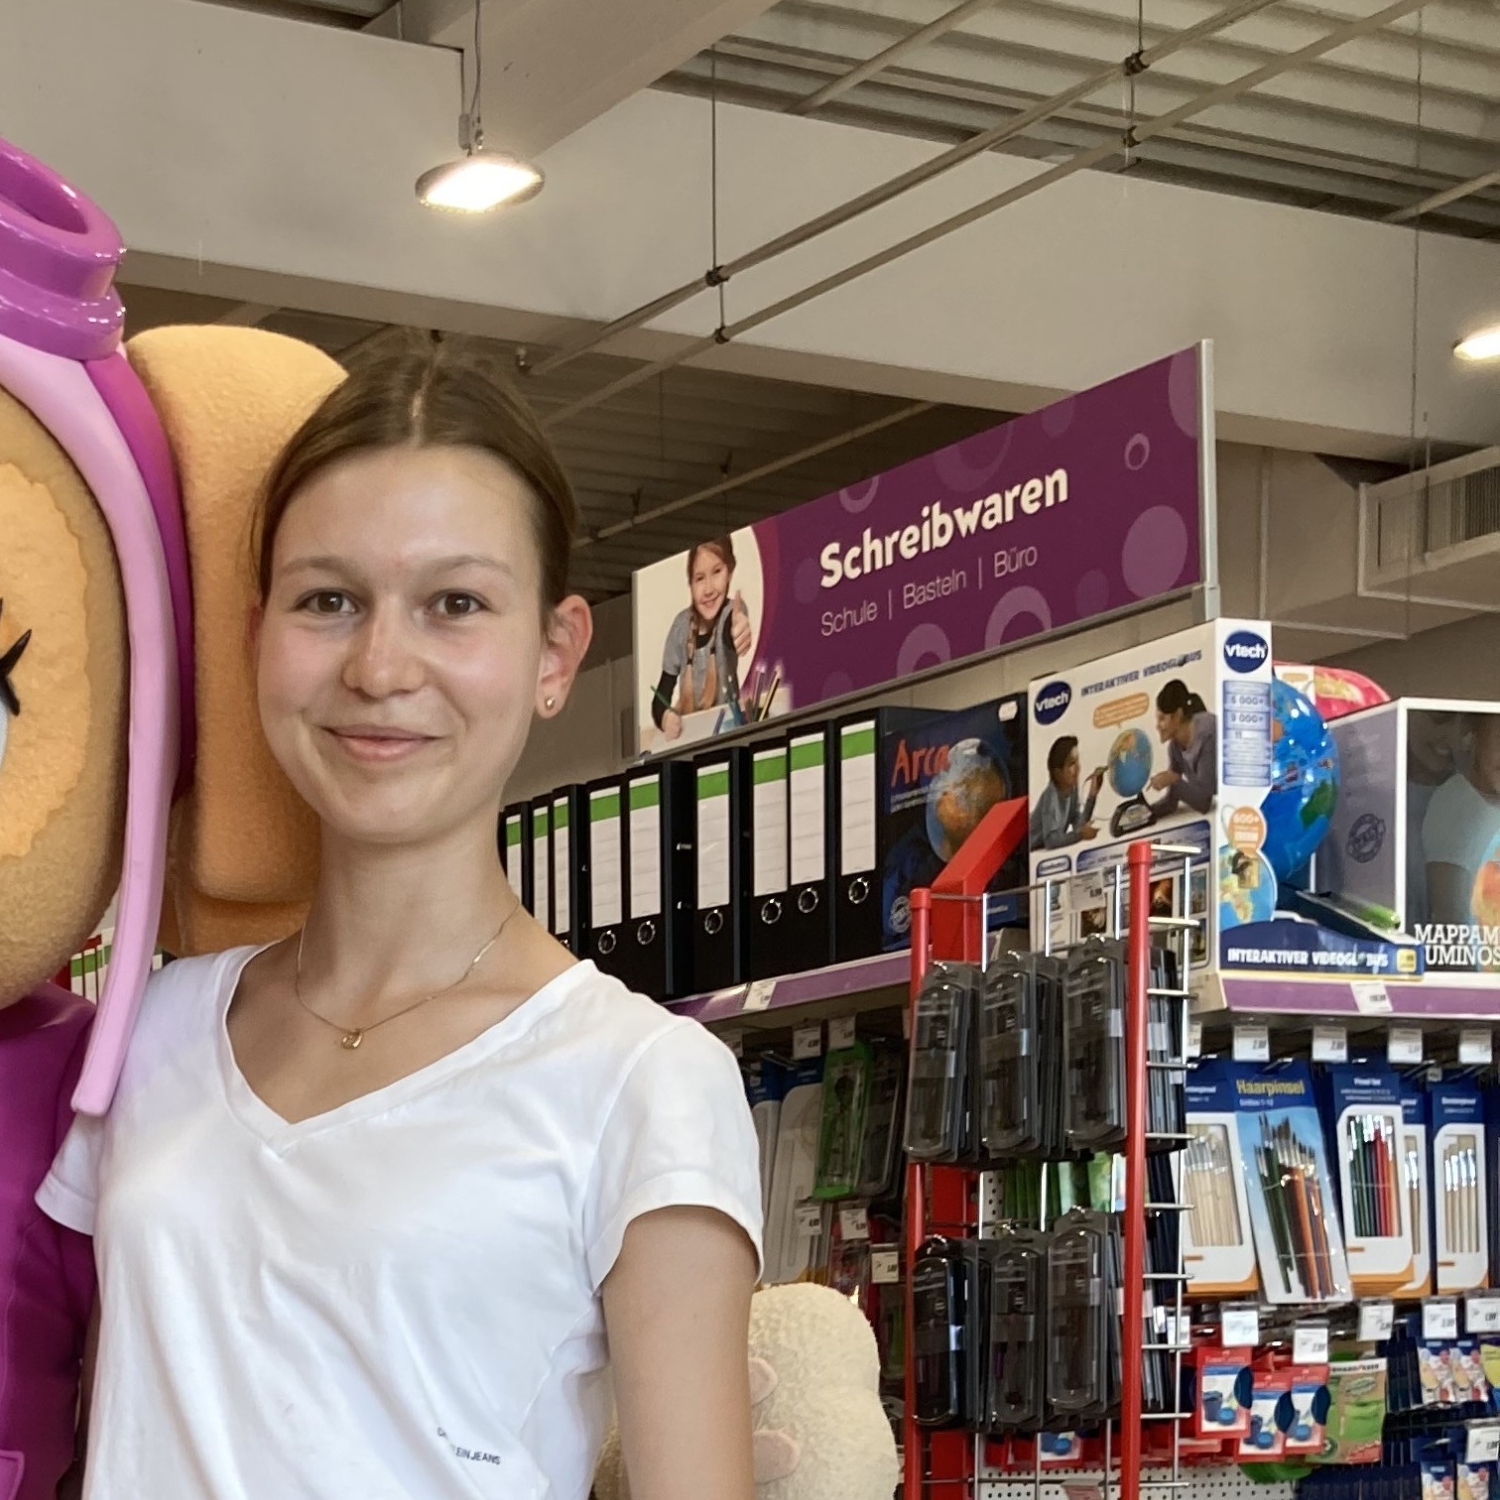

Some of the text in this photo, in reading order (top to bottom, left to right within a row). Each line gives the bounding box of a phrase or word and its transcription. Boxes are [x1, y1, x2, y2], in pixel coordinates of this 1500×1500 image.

[819, 467, 1069, 589] Schreibwaren
[820, 545, 1039, 637] Schule Basteln Büro
[1226, 643, 1266, 660] vtech
[1080, 670, 1141, 698] INTERAKTIVER
[1035, 692, 1069, 713] vtech
[1414, 923, 1500, 945] MAPPAM
[1227, 947, 1309, 965] INTERAKTIVER
[1425, 944, 1500, 966] UMINOS
[1236, 1079, 1306, 1097] Haarpinsel
[470, 1450, 501, 1465] JEANS
